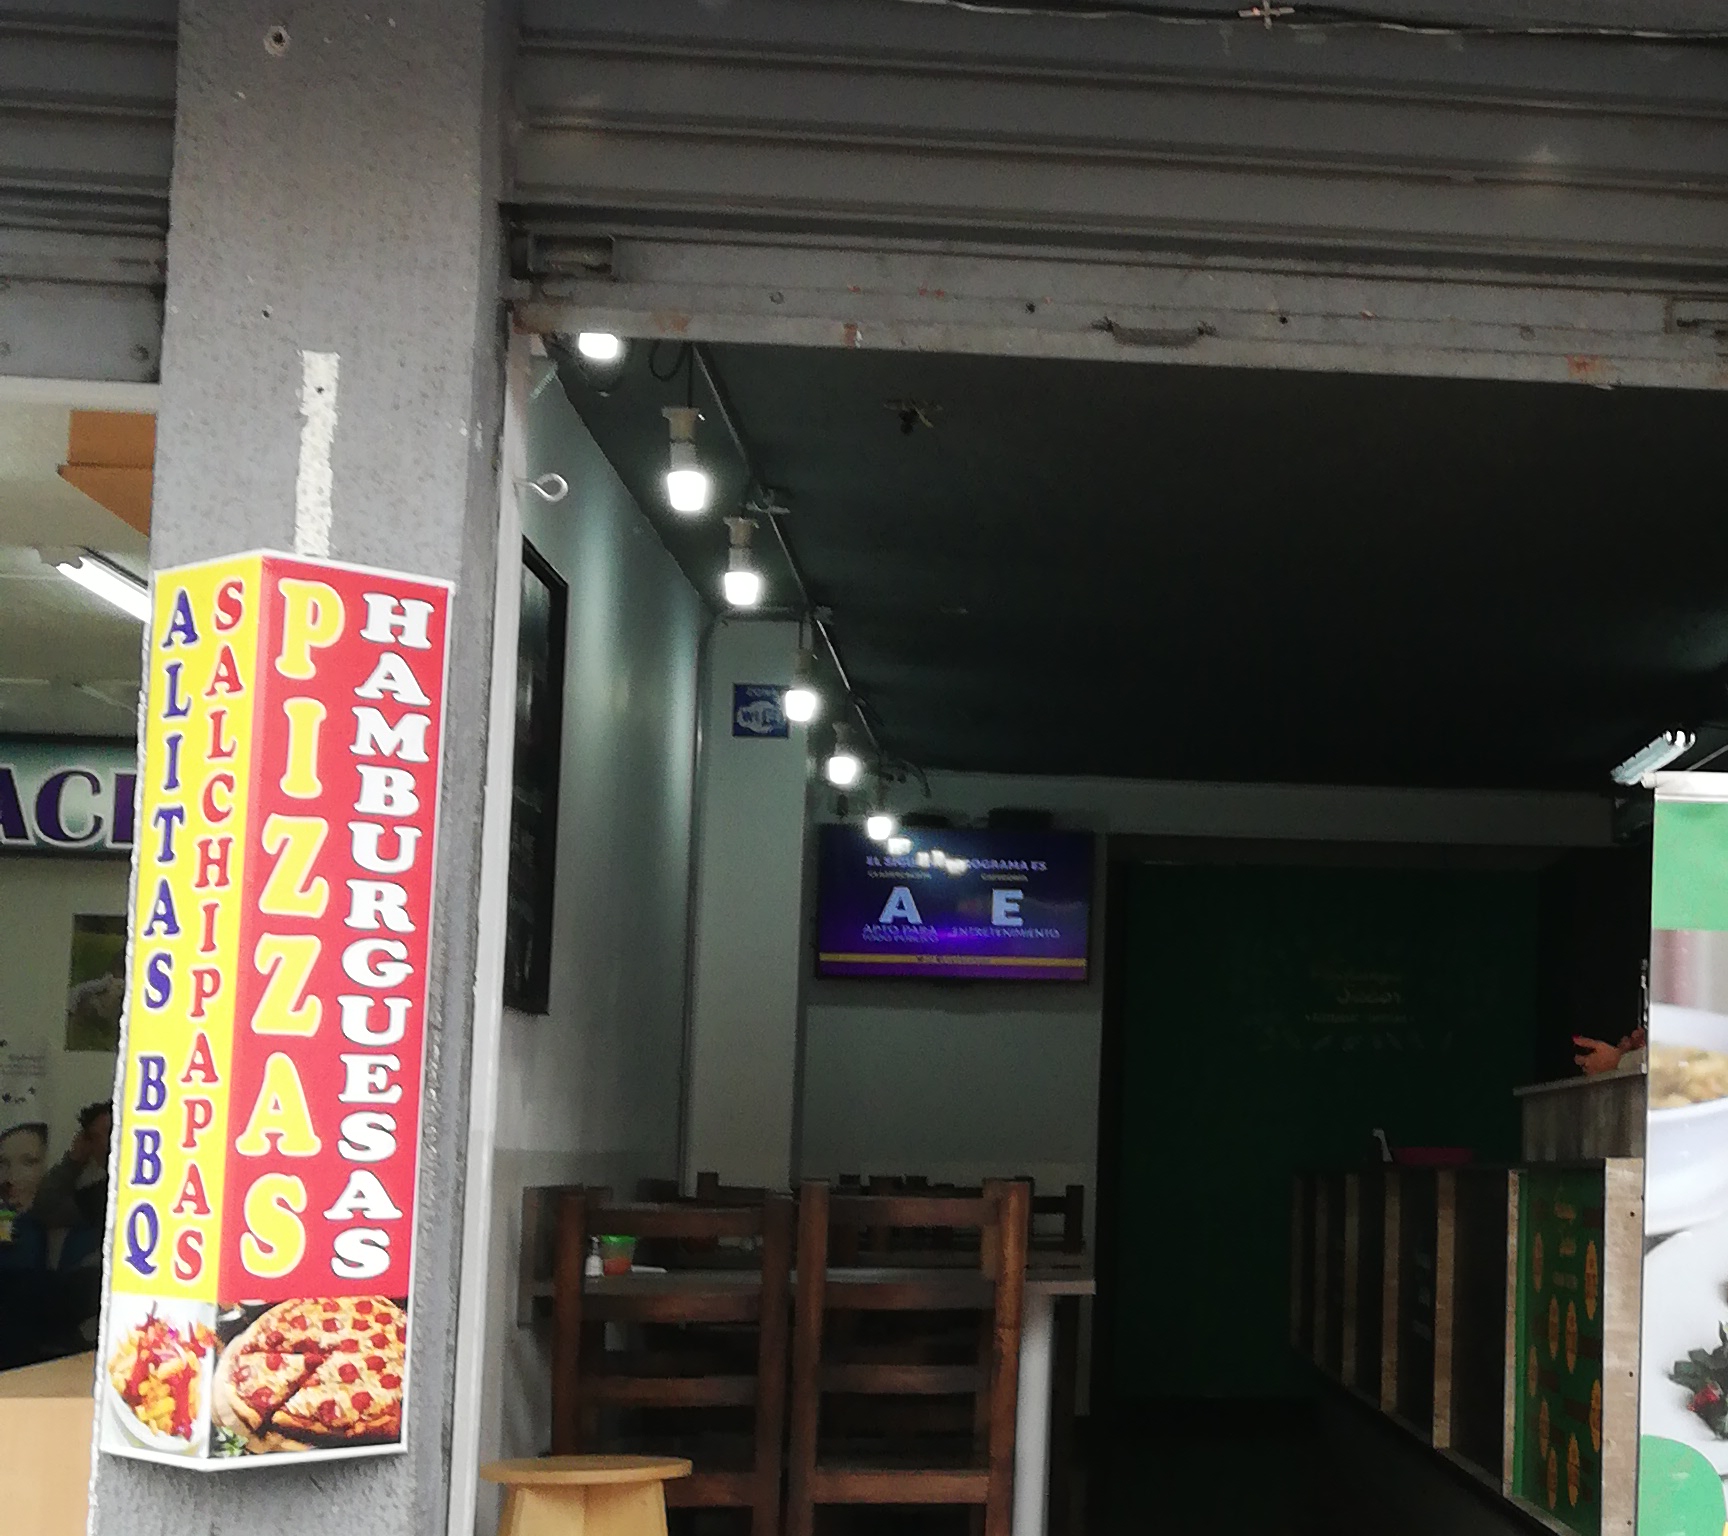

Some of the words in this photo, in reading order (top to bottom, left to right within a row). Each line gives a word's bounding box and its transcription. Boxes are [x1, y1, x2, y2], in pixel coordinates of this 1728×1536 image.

[145, 588, 199, 1011] ALITAS
[171, 579, 246, 1284] SALCHIPAPAS
[234, 577, 346, 1280] PIZZAS
[322, 589, 435, 1281] HAMBURGUESAS
[878, 885, 922, 925] A
[991, 888, 1024, 927] E
[124, 1053, 169, 1276] BBQ
